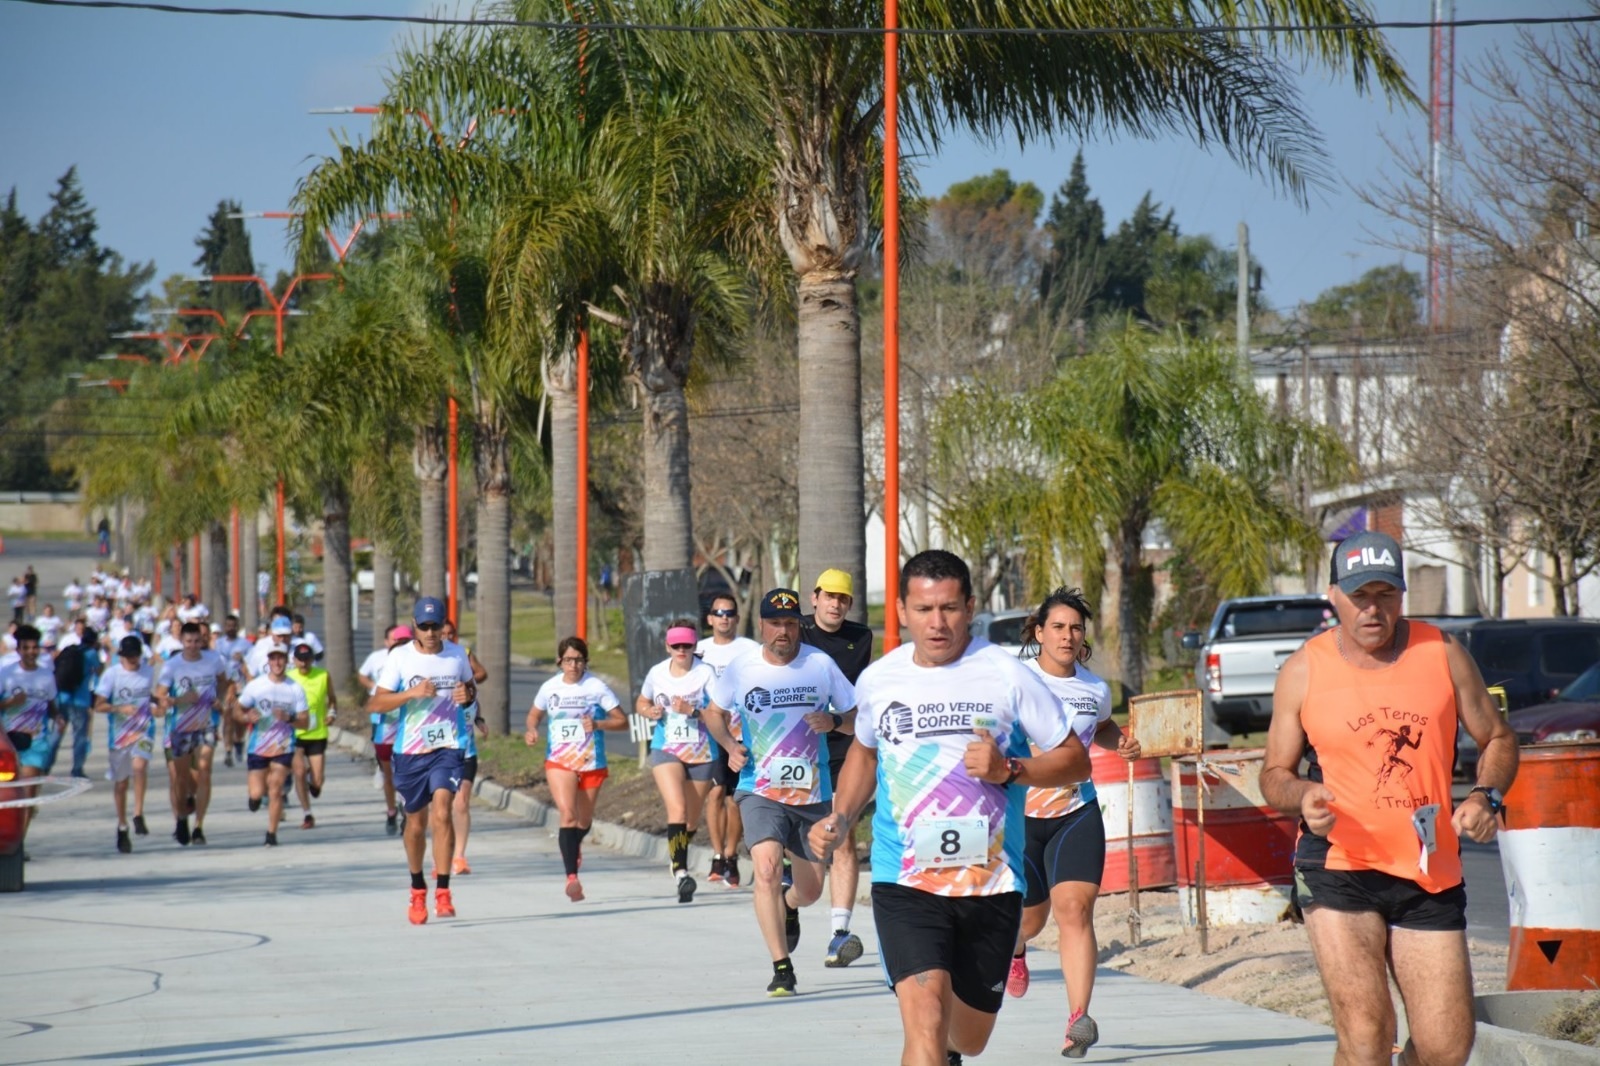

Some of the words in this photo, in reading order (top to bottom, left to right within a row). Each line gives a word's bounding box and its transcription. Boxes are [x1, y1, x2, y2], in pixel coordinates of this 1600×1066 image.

[1346, 547, 1396, 570] FILA
[792, 686, 817, 694] VERDE
[773, 694, 805, 703] CORRE
[917, 703, 945, 715] ORO
[949, 702, 993, 714] VERDE
[917, 714, 972, 729] CORRE
[1346, 713, 1375, 732] Los
[1379, 707, 1429, 726] Teros
[427, 728, 445, 743] 54
[561, 725, 578, 737] 57
[673, 726, 690, 738] 41
[780, 765, 805, 780] 20
[940, 829, 961, 855] 8
